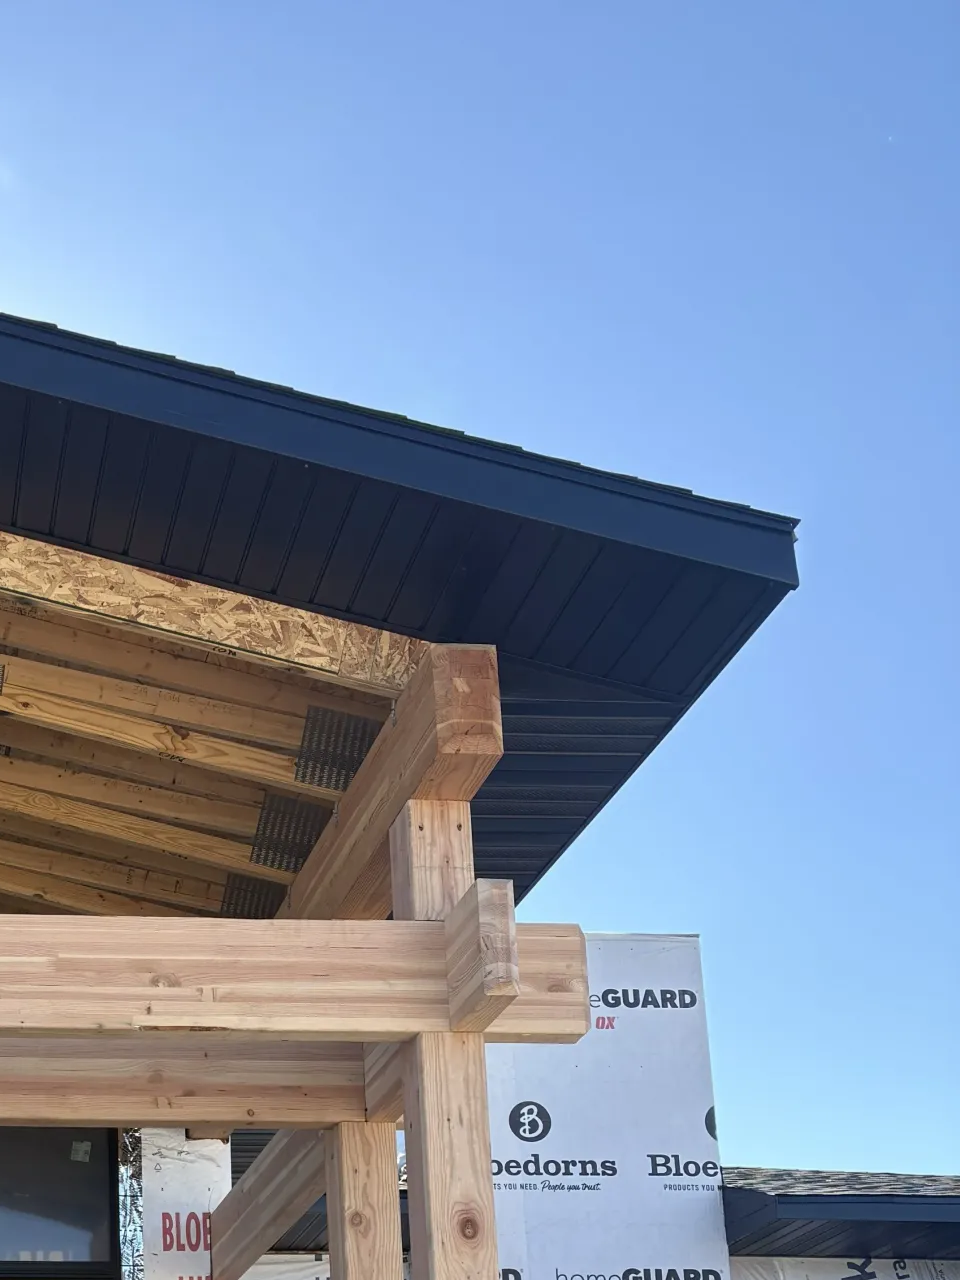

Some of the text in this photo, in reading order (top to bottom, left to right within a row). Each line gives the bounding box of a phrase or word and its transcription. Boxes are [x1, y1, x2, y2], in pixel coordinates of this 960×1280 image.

[589, 988, 697, 1009] eGUARD
[595, 1016, 616, 1030] OX
[647, 1153, 719, 1178] Bloe
[504, 1183, 517, 1191] YOU
[541, 1180, 565, 1192] People
[566, 1184, 581, 1192] you
[581, 1182, 602, 1191] trust.
[663, 1183, 715, 1192] PRODUCTS YOU
